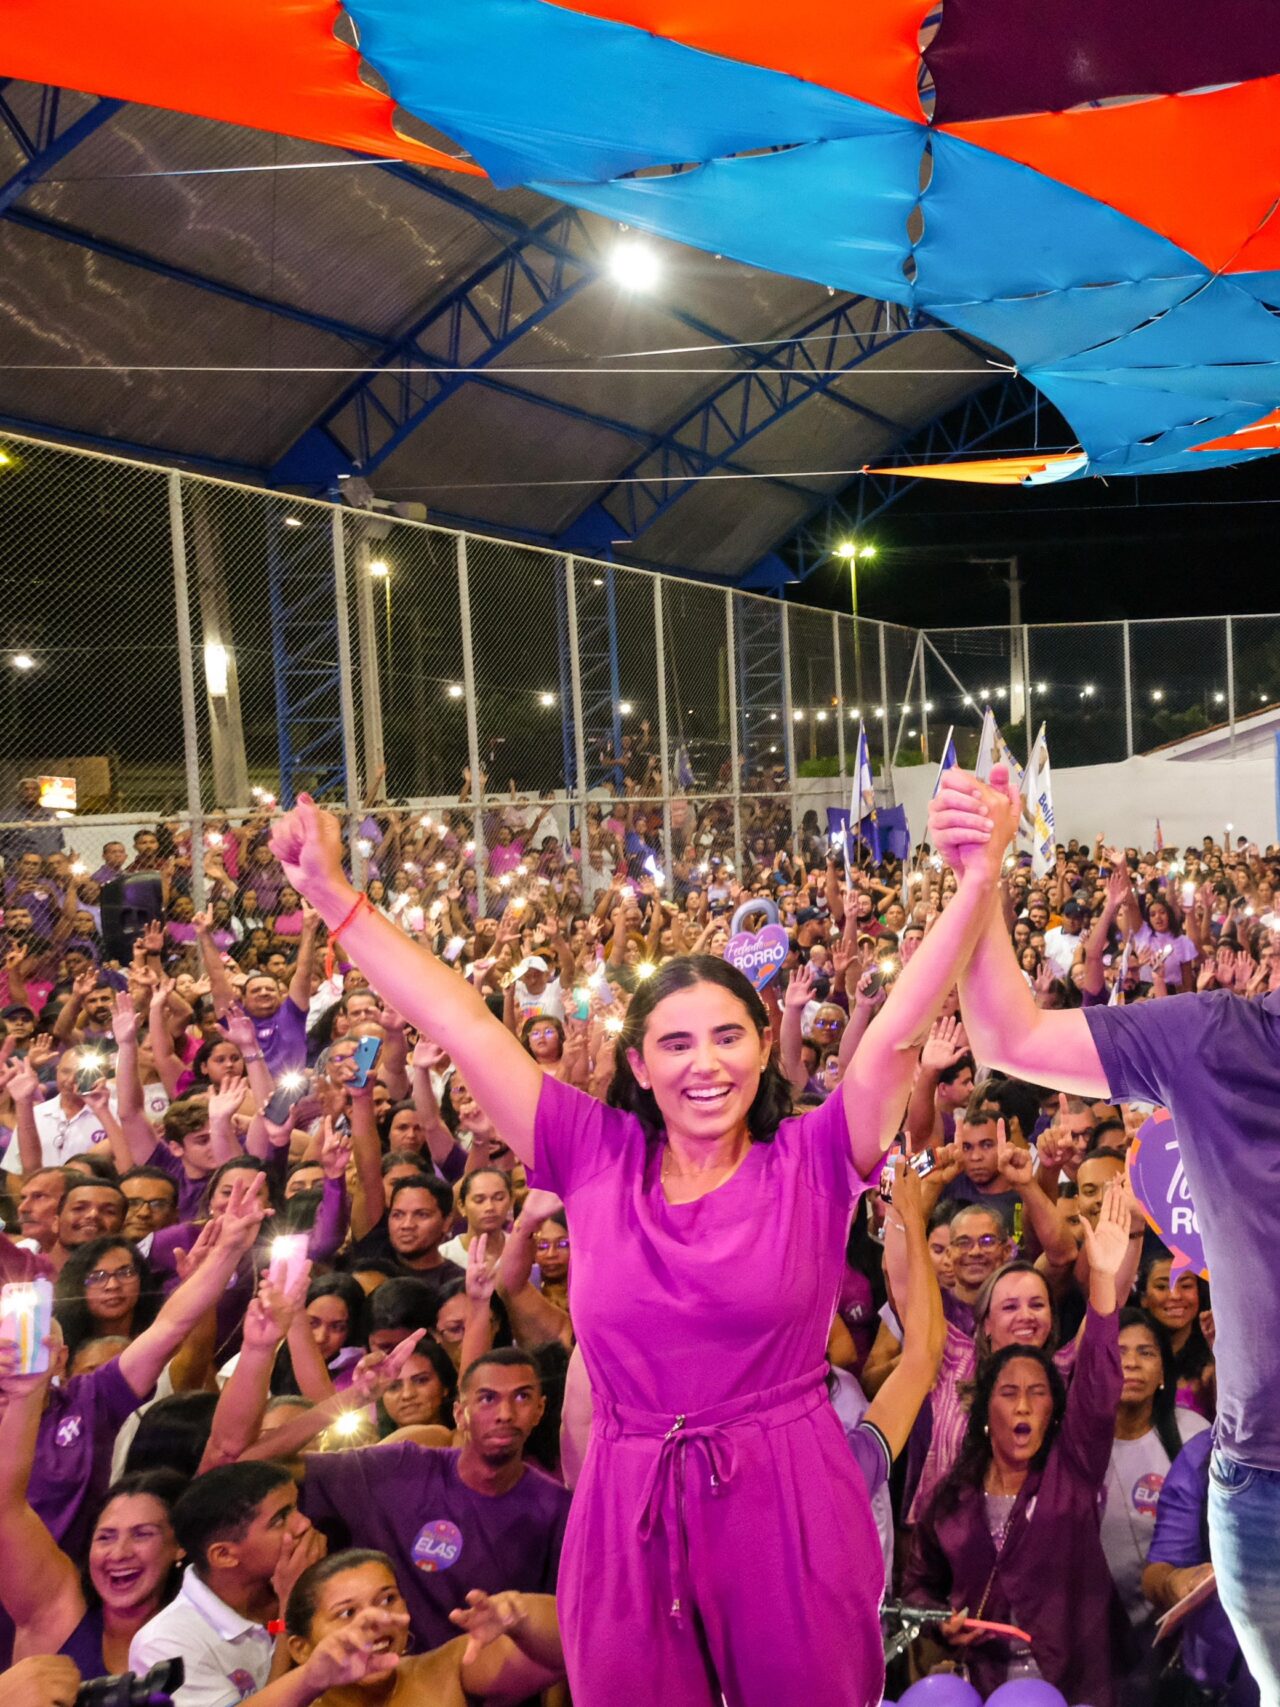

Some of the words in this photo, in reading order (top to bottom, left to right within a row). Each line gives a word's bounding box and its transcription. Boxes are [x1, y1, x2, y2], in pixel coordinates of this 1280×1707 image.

[733, 941, 785, 970] RORRÓ
[1134, 1486, 1160, 1503] ELA
[415, 1536, 457, 1560] ELAS
